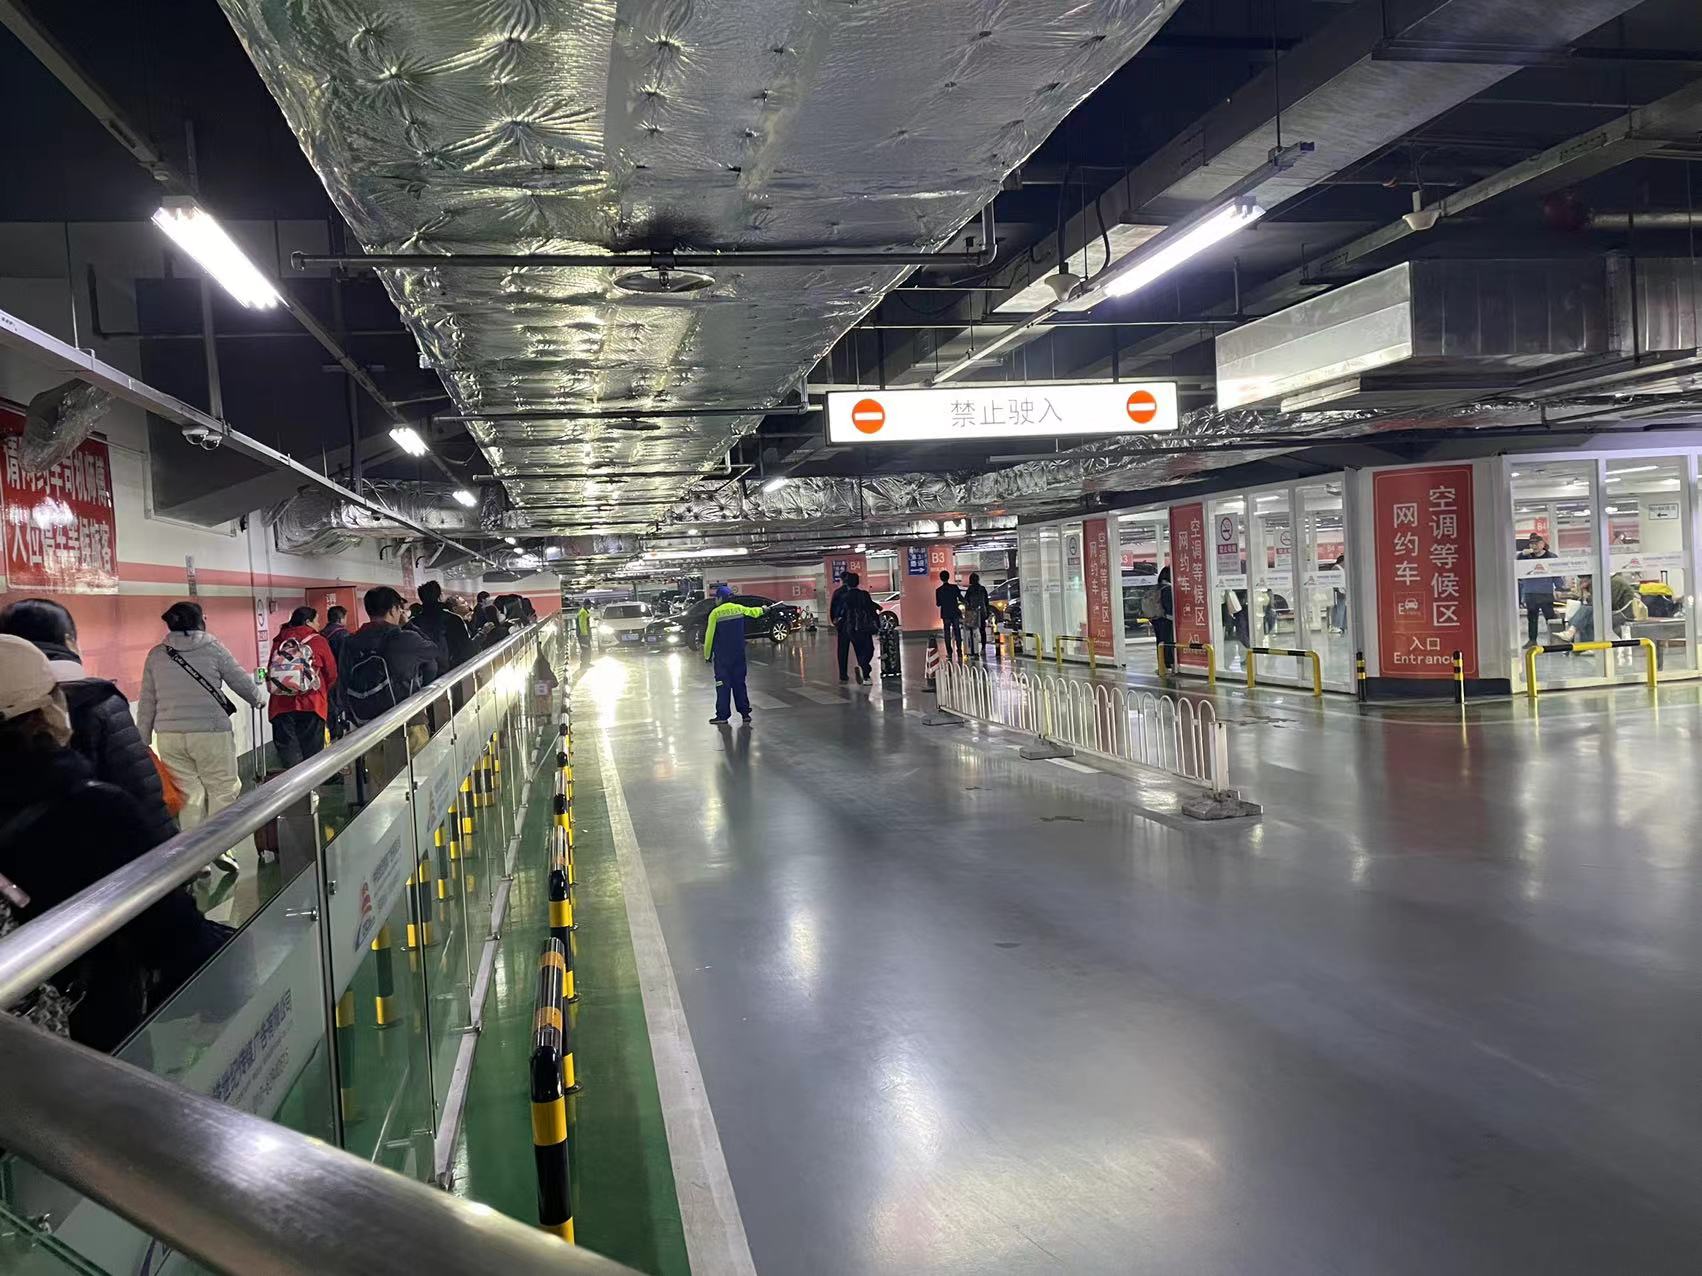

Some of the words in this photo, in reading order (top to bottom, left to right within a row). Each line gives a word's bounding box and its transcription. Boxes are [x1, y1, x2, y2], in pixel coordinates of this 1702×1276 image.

[950, 396, 1063, 428] 禁止驶入
[931, 551, 945, 564] B3
[1177, 530, 1192, 595] 网约车
[1392, 502, 1421, 587] 网约车
[1428, 484, 1461, 628] 空调等候区
[1190, 517, 1206, 627] 空调等候区
[1393, 652, 1455, 665] Entranc
[1409, 636, 1440, 651] 入口
